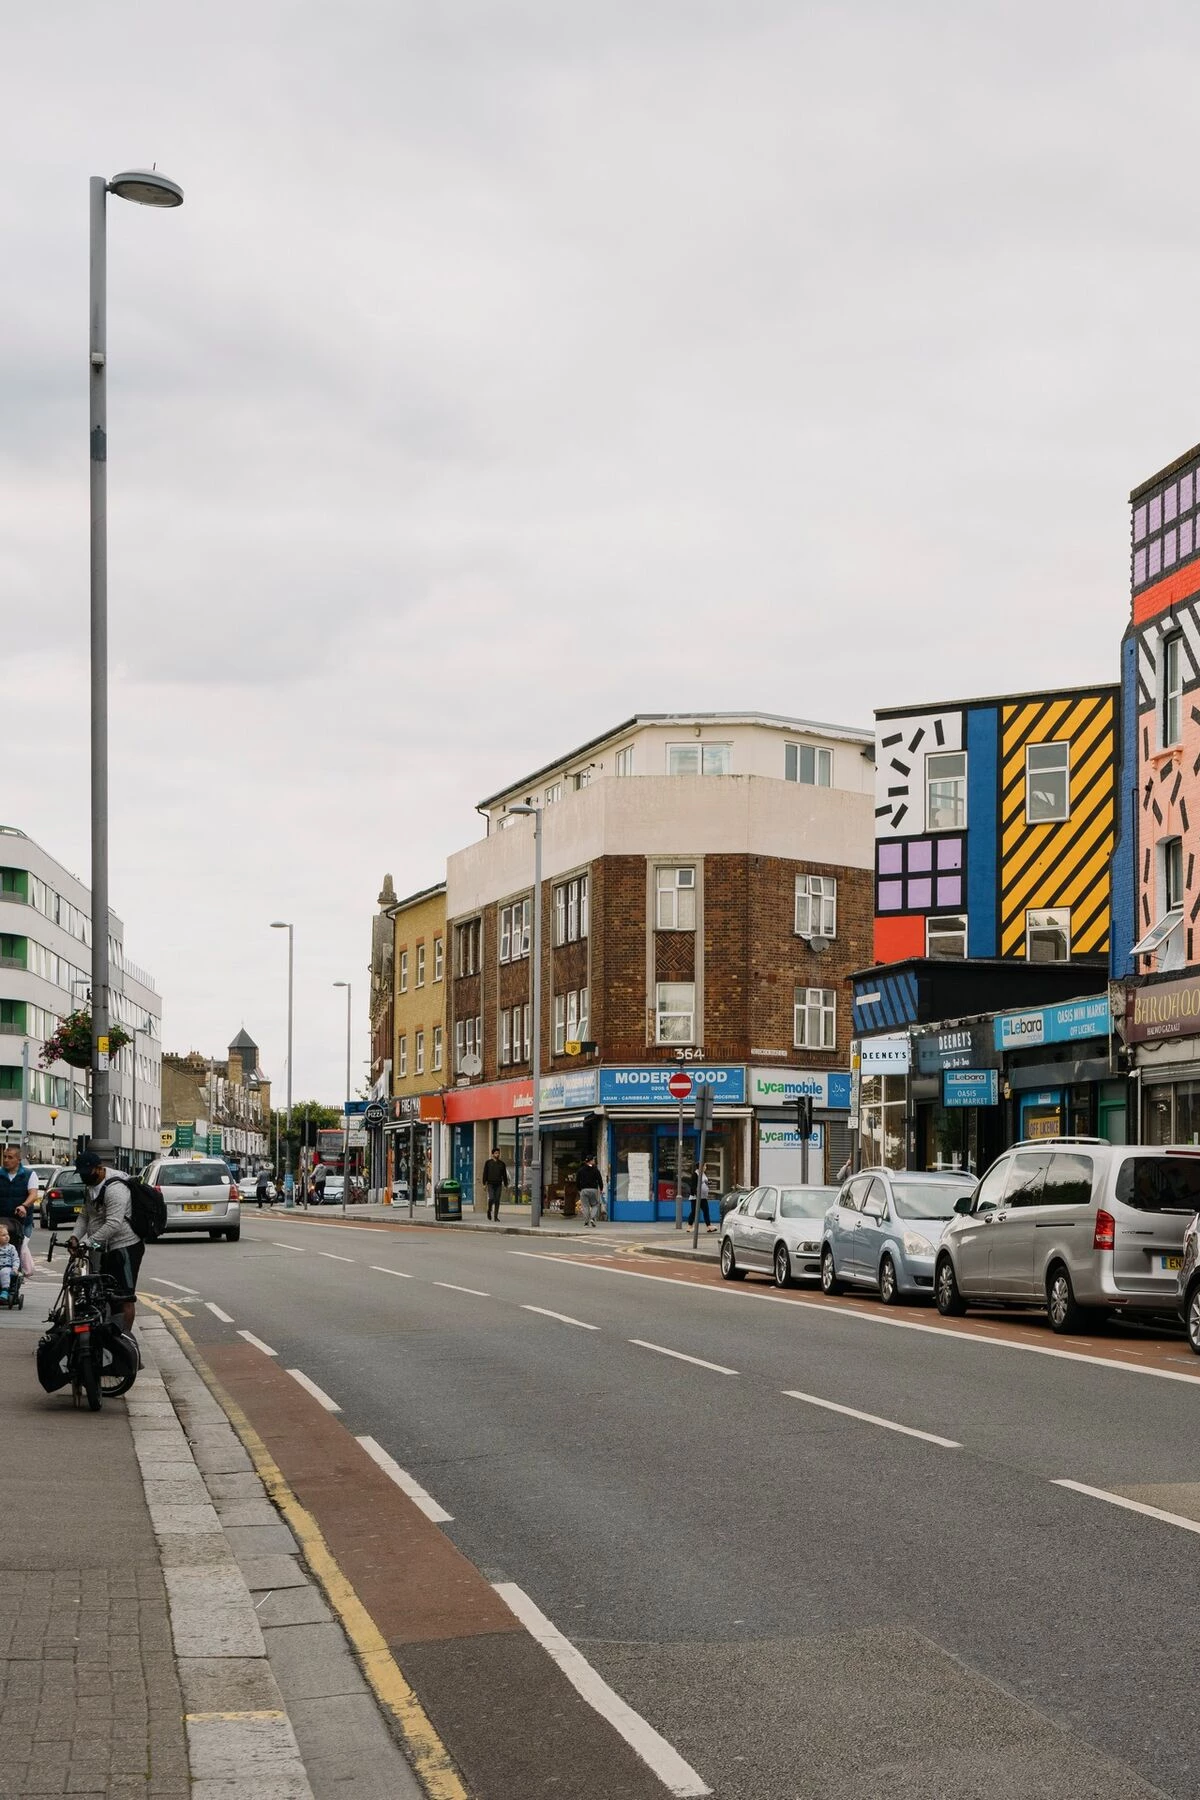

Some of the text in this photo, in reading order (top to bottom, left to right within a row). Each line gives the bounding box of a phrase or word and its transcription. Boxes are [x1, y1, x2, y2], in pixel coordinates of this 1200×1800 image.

[1057, 1002, 1108, 1024] OASIS MINI MARKET
[1010, 1018, 1042, 1035] Lebara
[1070, 1026, 1078, 1036] OFF
[939, 1031, 972, 1050] DEENEY'S
[674, 1048, 705, 1060] 364
[862, 1051, 907, 1060] DEENEY'S
[955, 1073, 985, 1081] Lebara
[757, 1079, 823, 1095] Lycamobile
[957, 1089, 977, 1097] OASIS
[1029, 1119, 1060, 1136] OFF LICENCE
